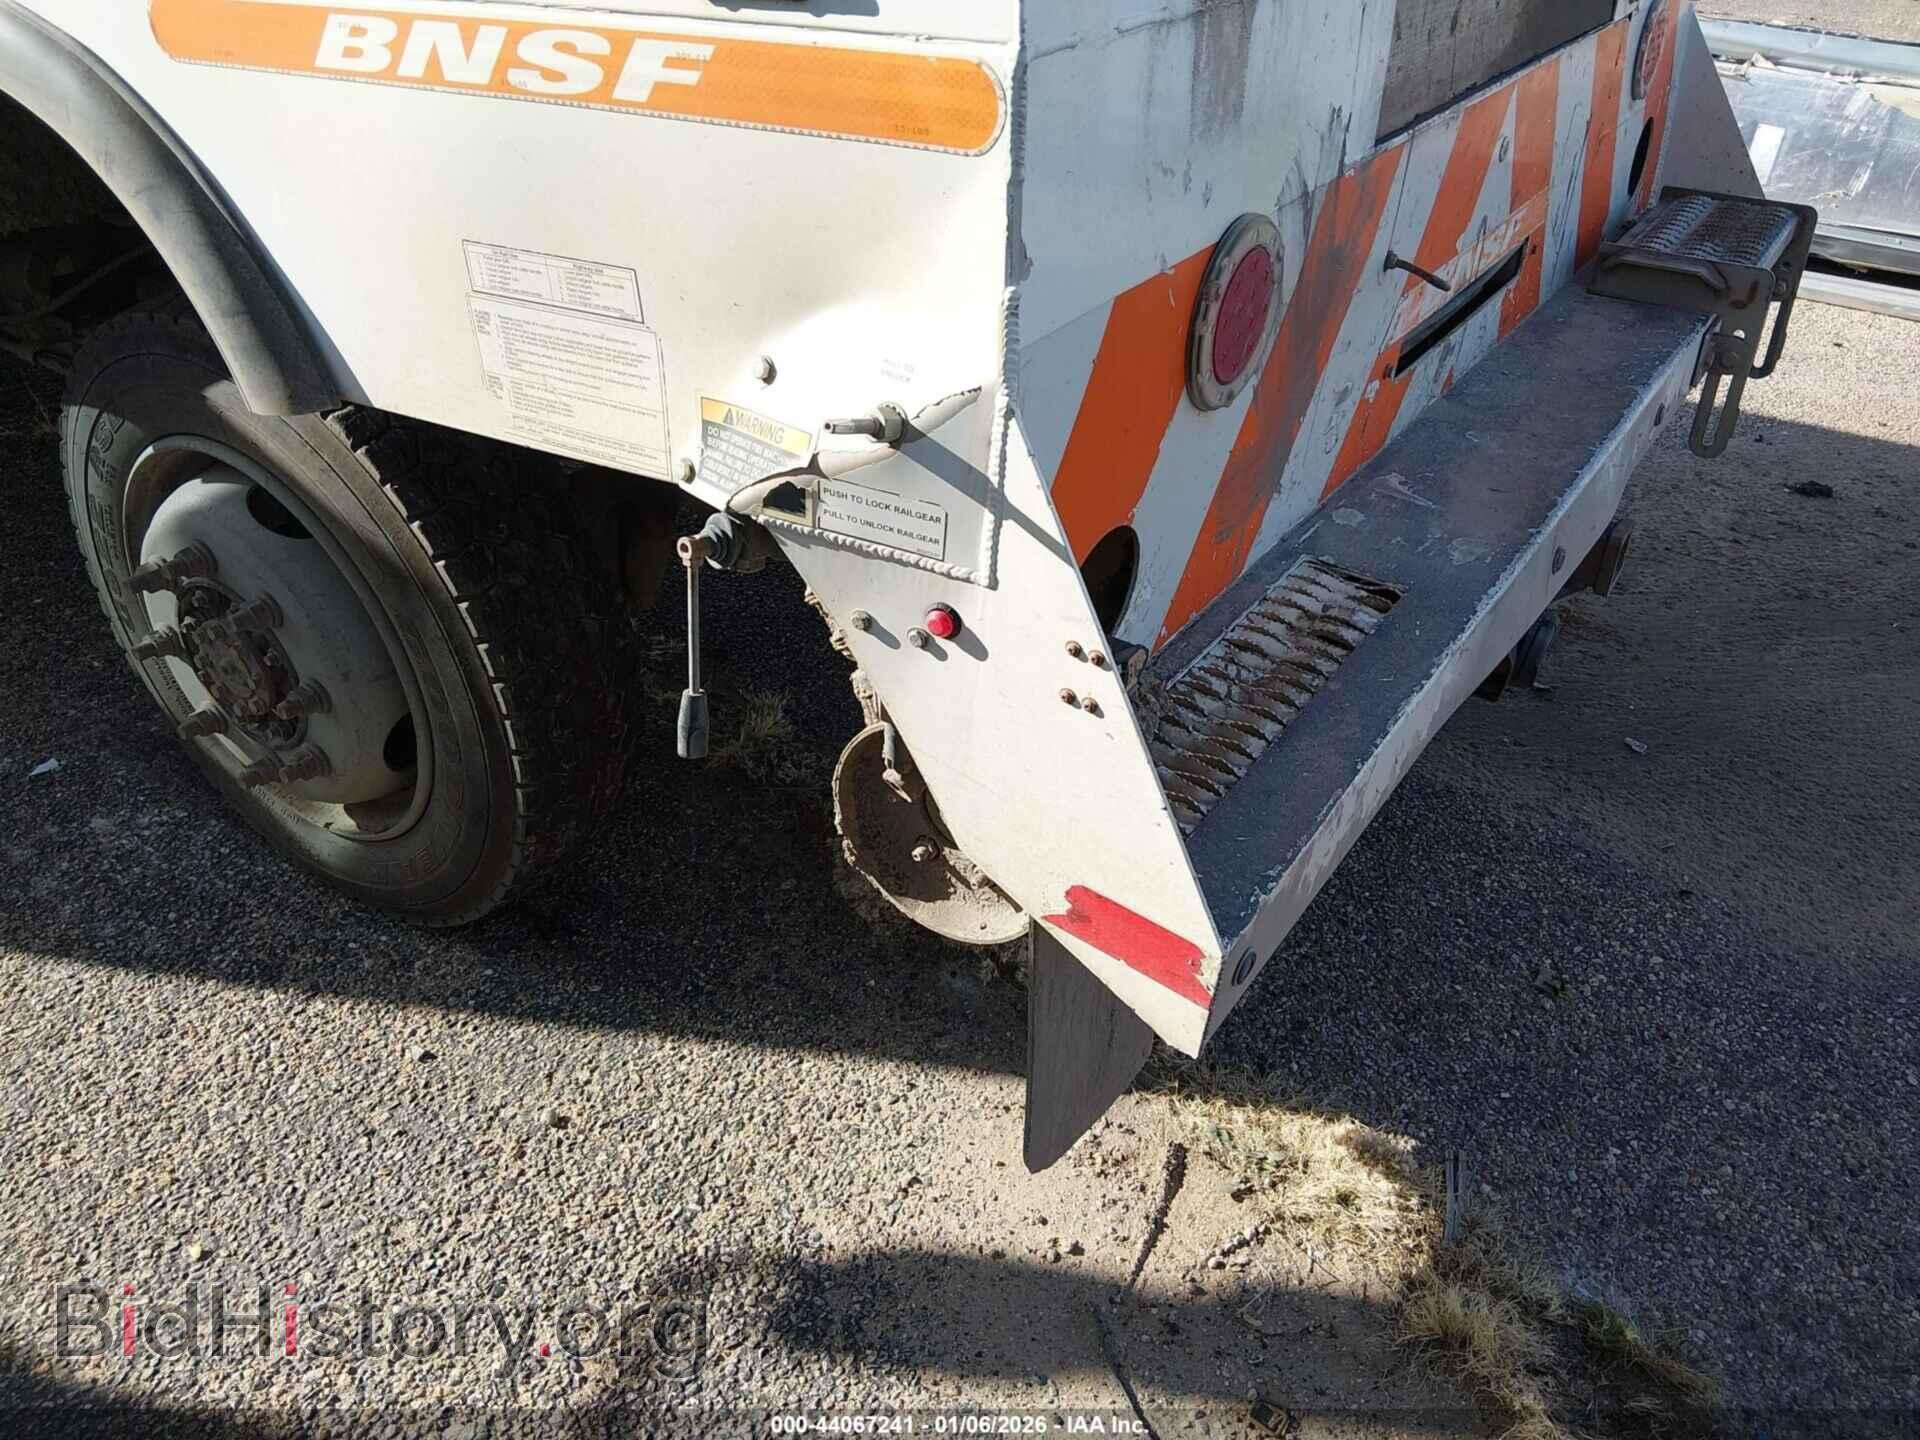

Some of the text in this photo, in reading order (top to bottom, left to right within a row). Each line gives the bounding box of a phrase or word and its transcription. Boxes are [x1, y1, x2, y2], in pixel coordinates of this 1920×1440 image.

[313, 13, 716, 104] BNSF
[707, 426, 720, 437] DO
[735, 410, 786, 445] WARNING
[823, 486, 942, 525] PUSH TO LOCK RAILGEAR
[823, 508, 941, 545] PULL TO UNLOCK RAILGEAR
